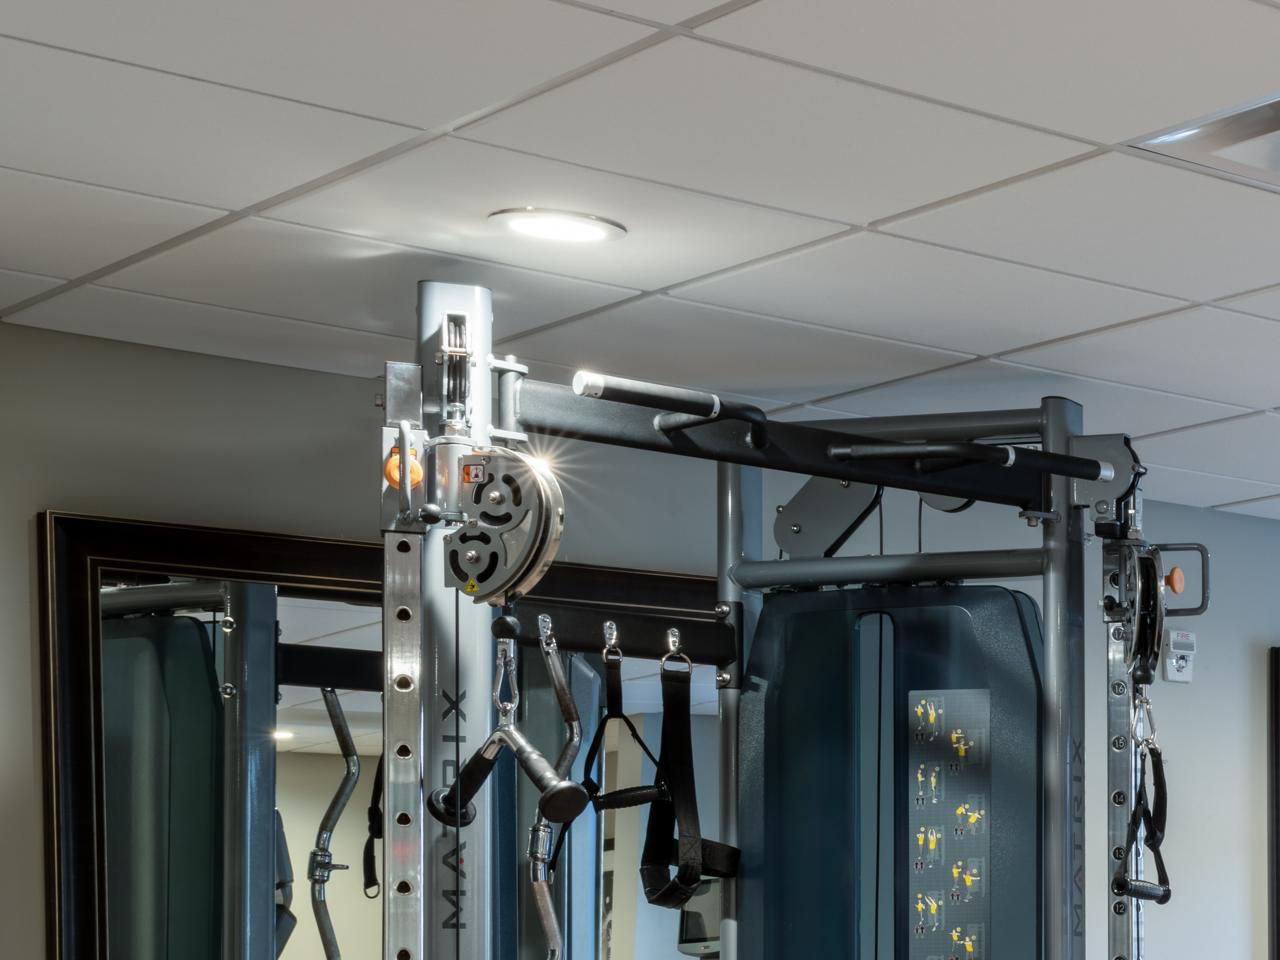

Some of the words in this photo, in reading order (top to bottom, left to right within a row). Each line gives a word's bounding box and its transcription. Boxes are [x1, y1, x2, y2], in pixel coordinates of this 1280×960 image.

[1176, 632, 1191, 641] FIRE
[1115, 685, 1125, 693] 16
[1115, 739, 1124, 748] 15
[1115, 794, 1124, 803] 14
[1116, 904, 1125, 913] 12
